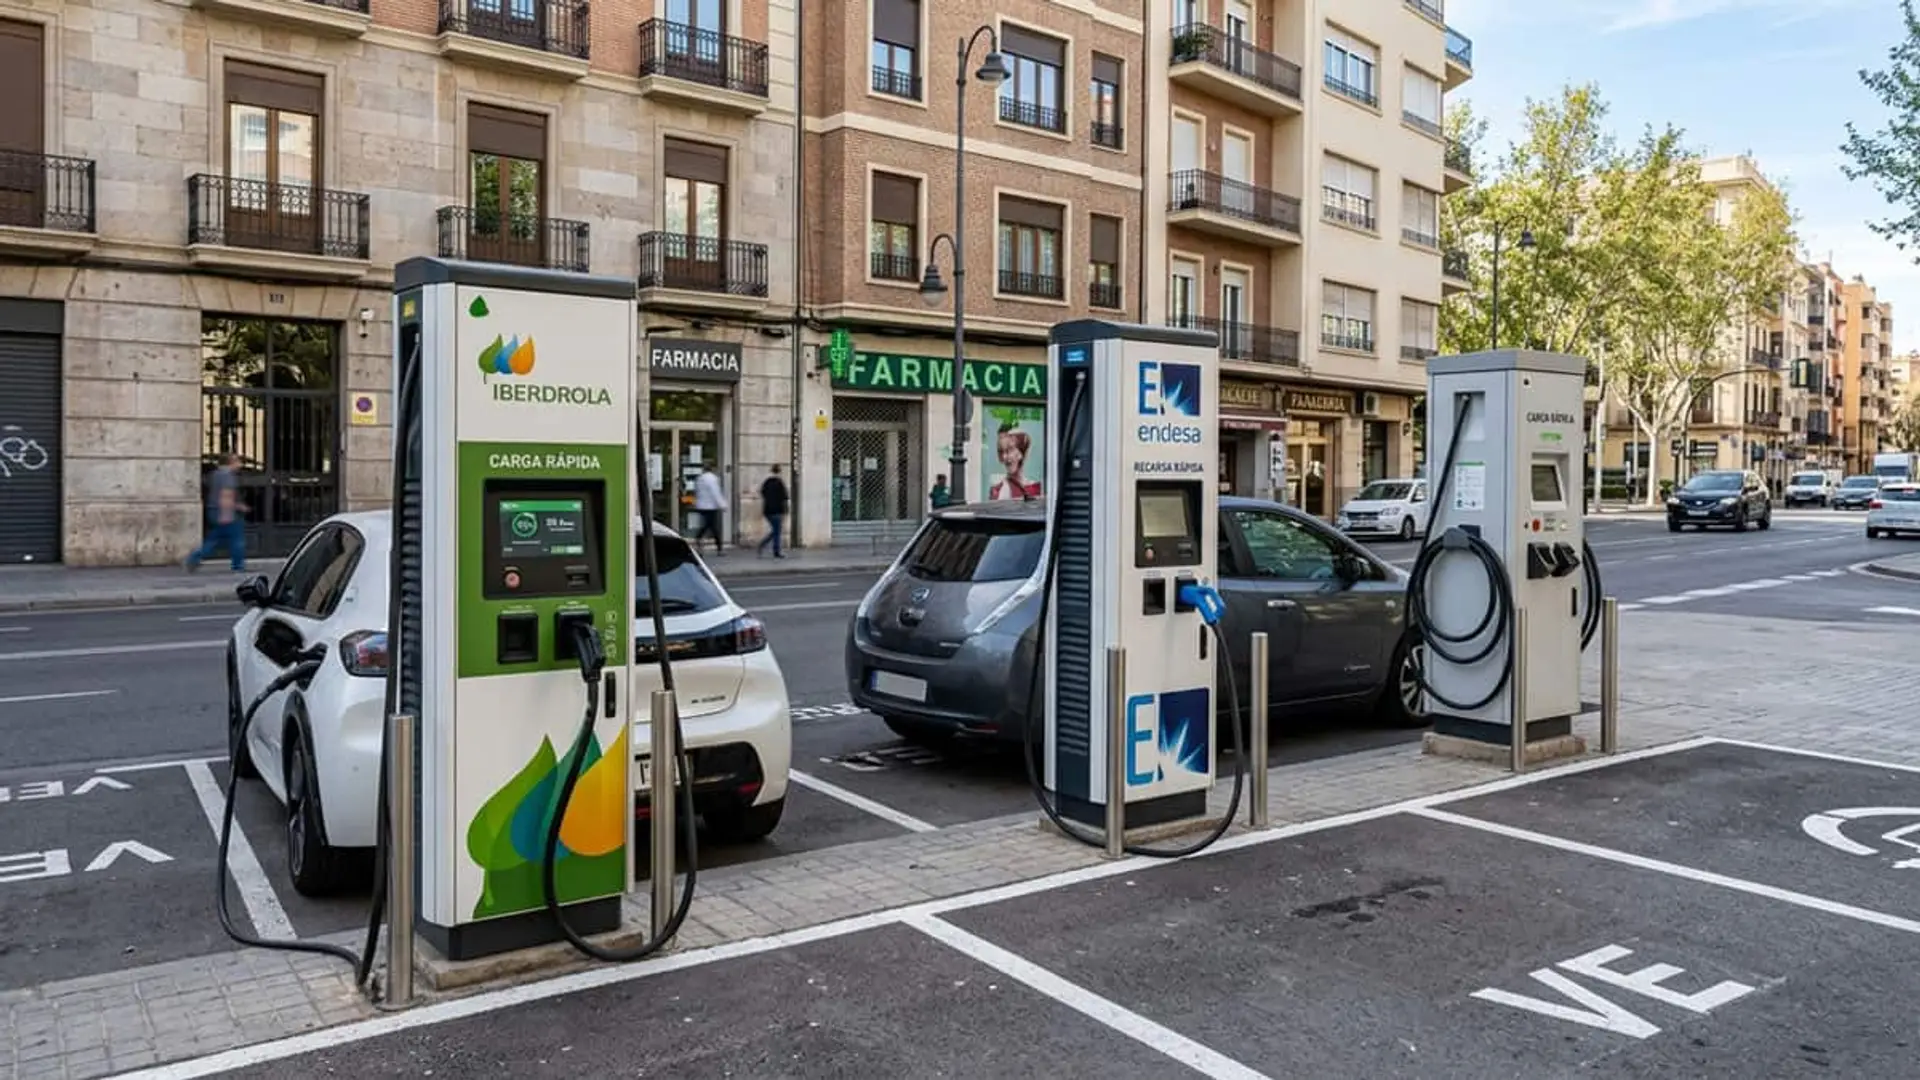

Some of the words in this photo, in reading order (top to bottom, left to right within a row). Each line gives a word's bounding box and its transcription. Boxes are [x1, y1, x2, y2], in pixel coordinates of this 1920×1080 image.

[652, 349, 739, 372] FARMACIA
[849, 354, 1041, 395] FARMACIA
[493, 384, 612, 405] IBERDROLA
[1138, 422, 1202, 443] endesa
[489, 454, 542, 469] CARGA
[545, 451, 601, 470] RÁPIDA
[1469, 943, 1756, 1039] VE
